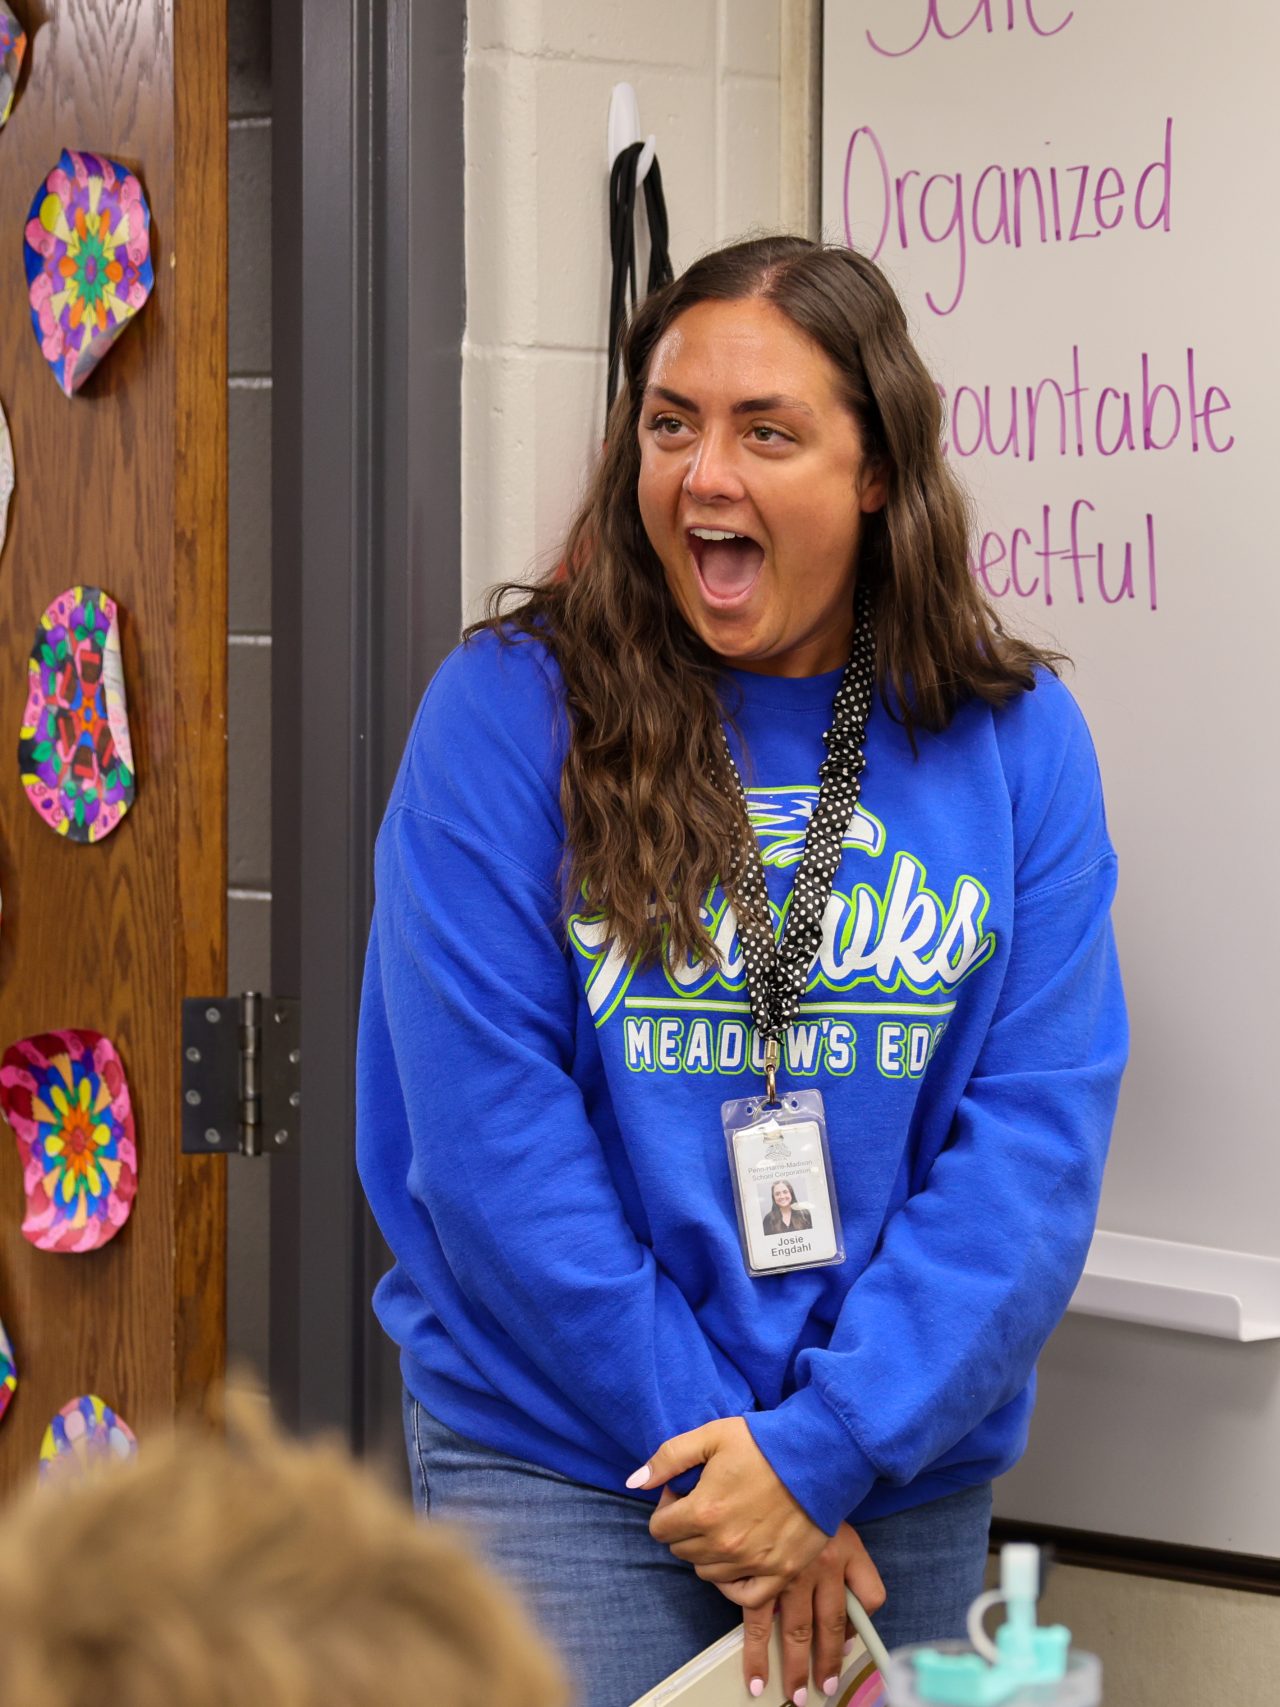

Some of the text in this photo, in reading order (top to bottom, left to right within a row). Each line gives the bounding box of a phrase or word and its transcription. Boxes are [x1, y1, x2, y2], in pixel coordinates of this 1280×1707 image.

[843, 117, 1172, 316] Organized
[967, 499, 1157, 611] ectful
[771, 1243, 812, 1257] Engdahl
[778, 1235, 804, 1247] Josie
